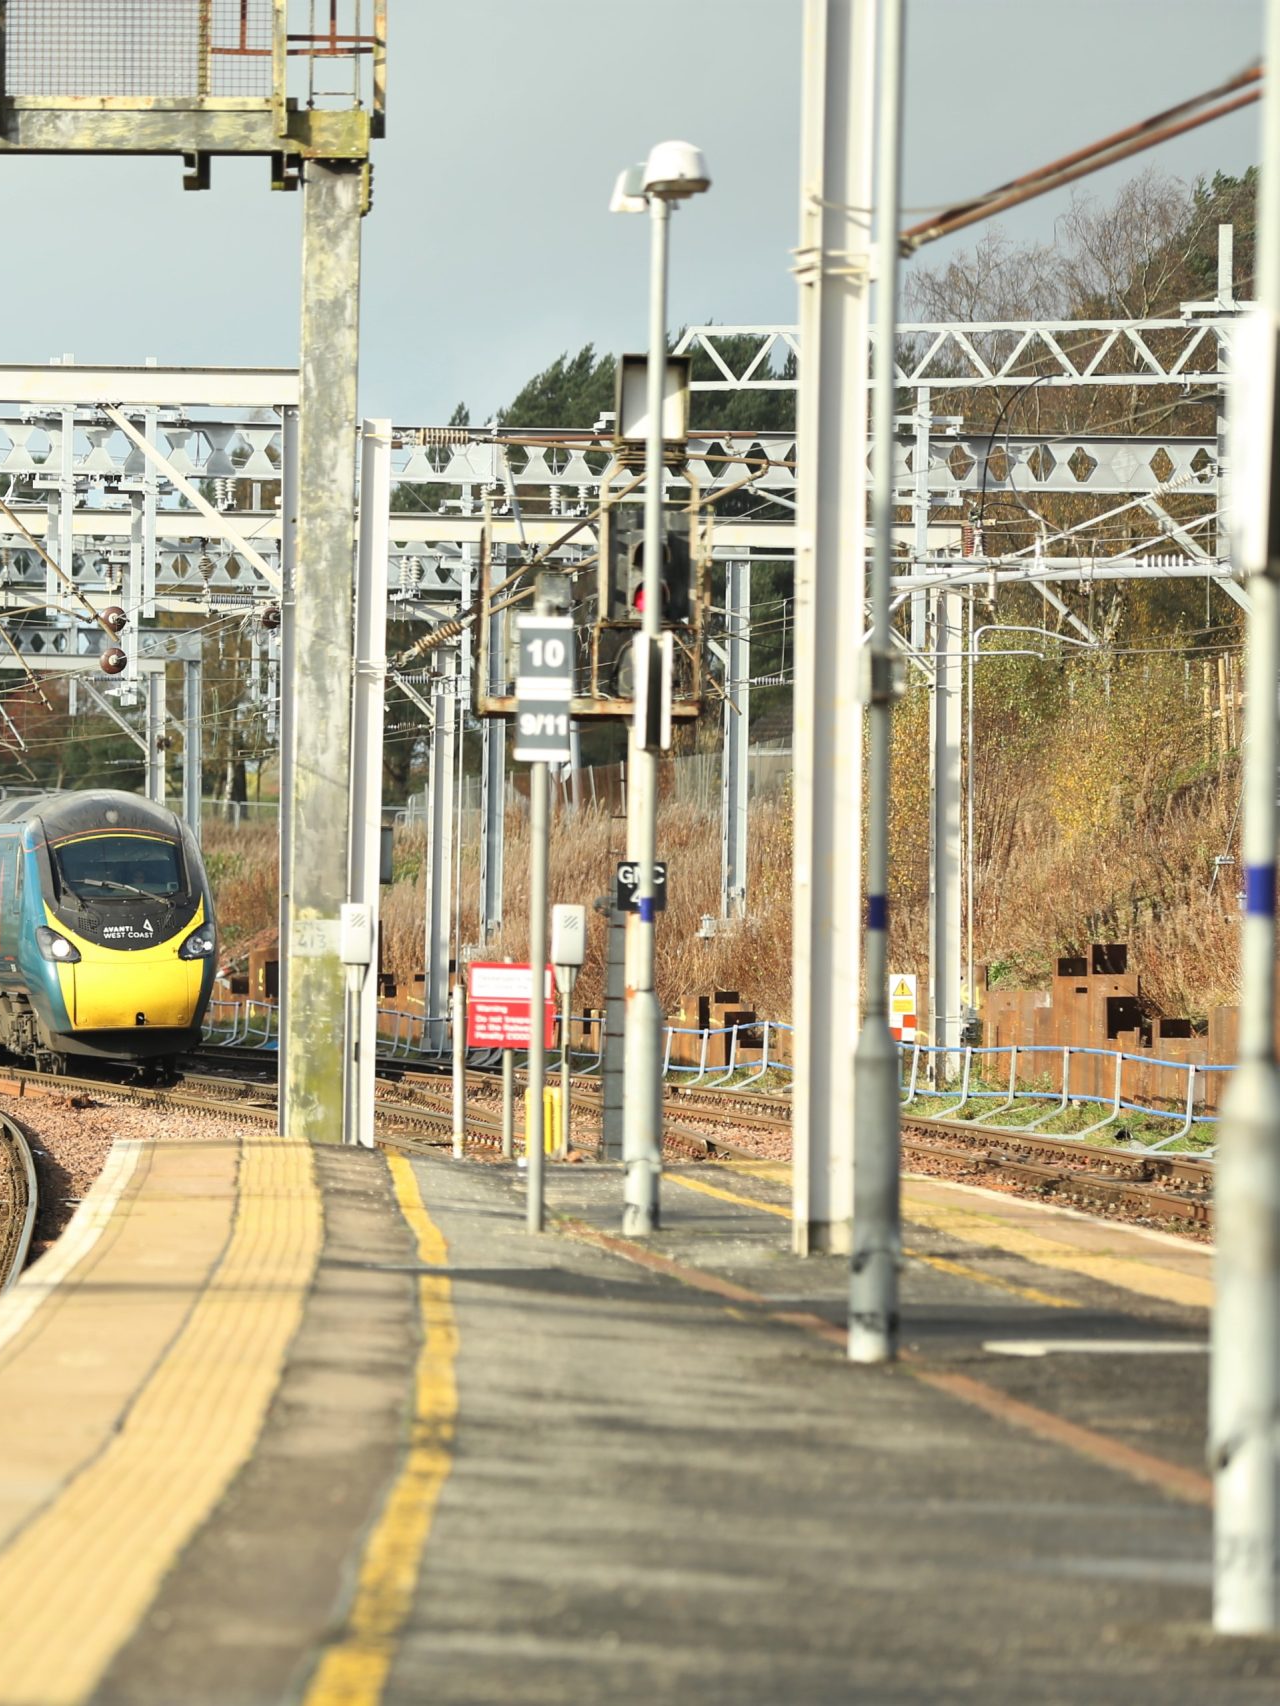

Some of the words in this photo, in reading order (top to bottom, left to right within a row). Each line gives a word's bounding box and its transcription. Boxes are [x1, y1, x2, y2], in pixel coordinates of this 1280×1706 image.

[526, 637, 566, 668] 10
[520, 713, 568, 736] 9/11
[103, 925, 134, 933] AVANTI
[127, 931, 154, 939] COAST
